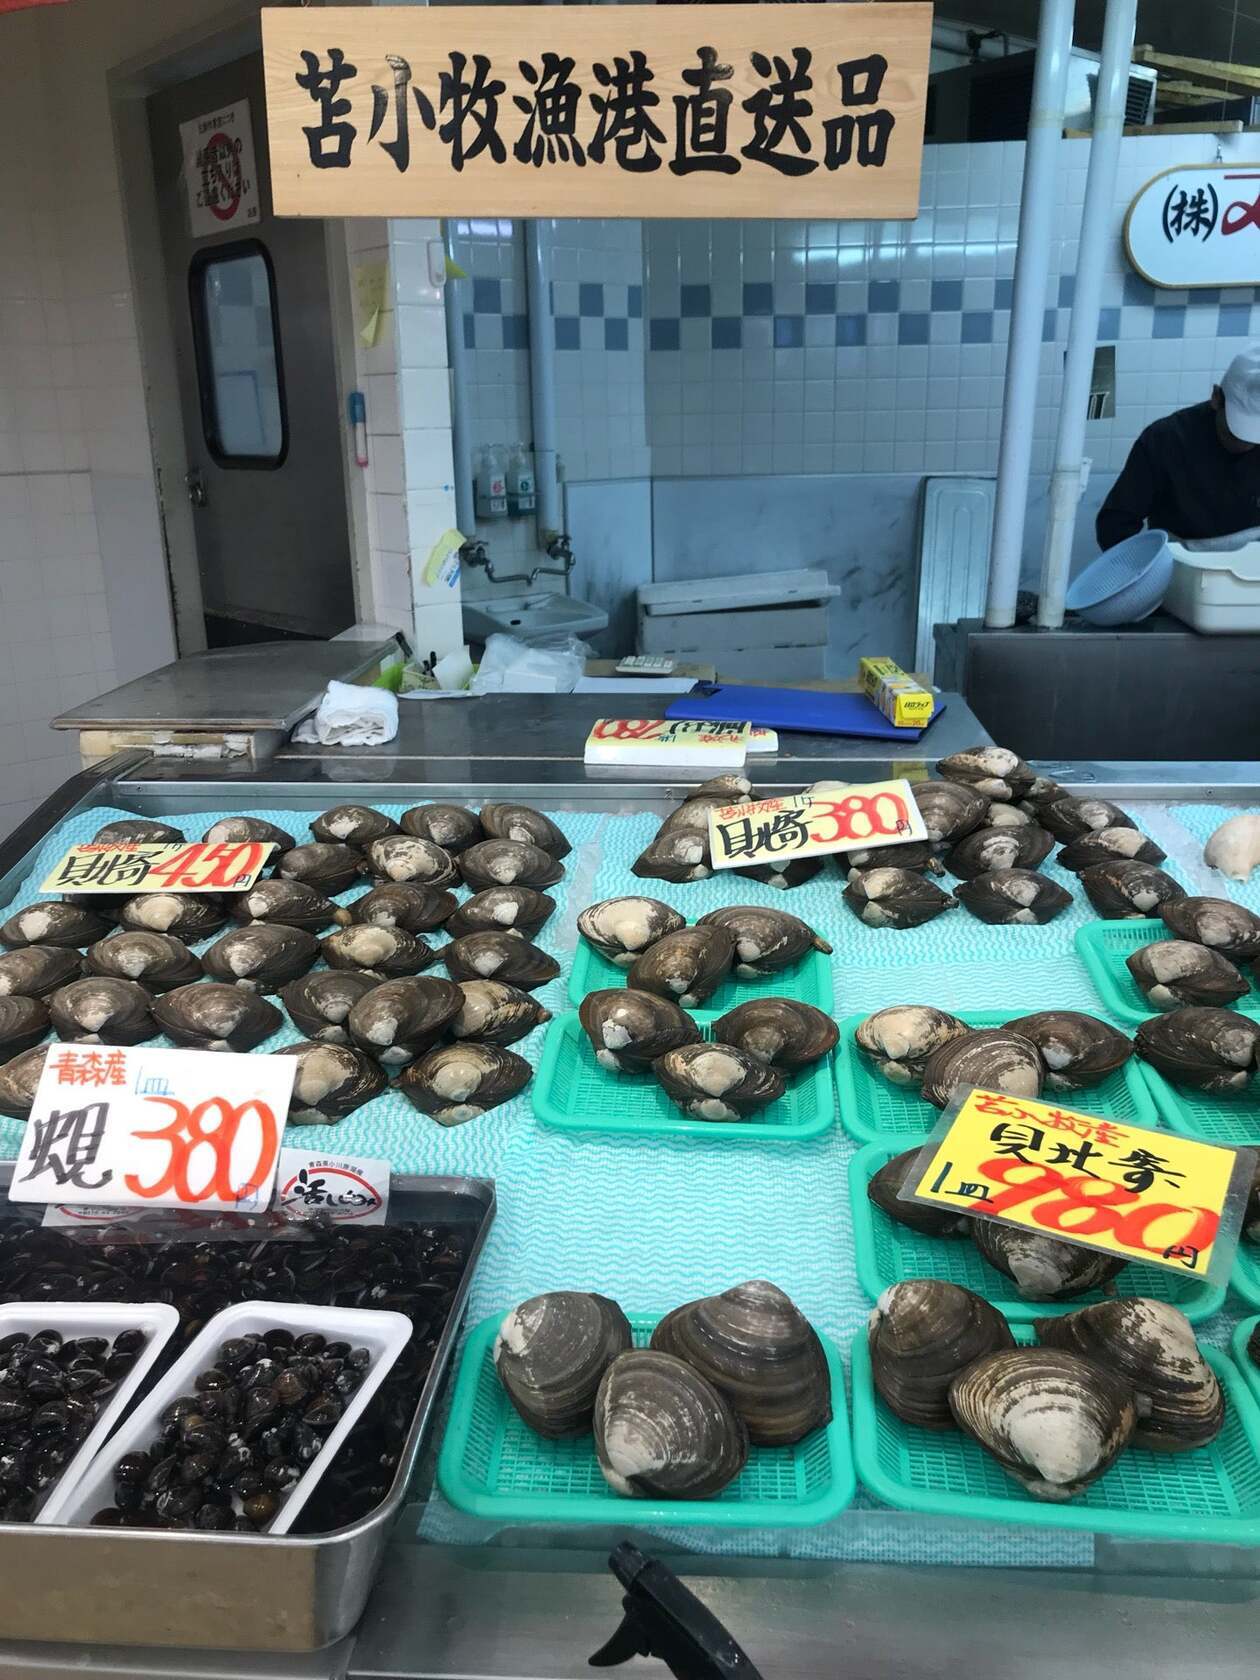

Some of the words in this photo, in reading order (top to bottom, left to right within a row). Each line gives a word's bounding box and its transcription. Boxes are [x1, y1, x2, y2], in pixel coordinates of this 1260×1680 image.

[295, 46, 896, 177] 苫小牧漁港直送品
[49, 1050, 128, 1087] 青森産
[18, 1101, 114, 1189] 蜆
